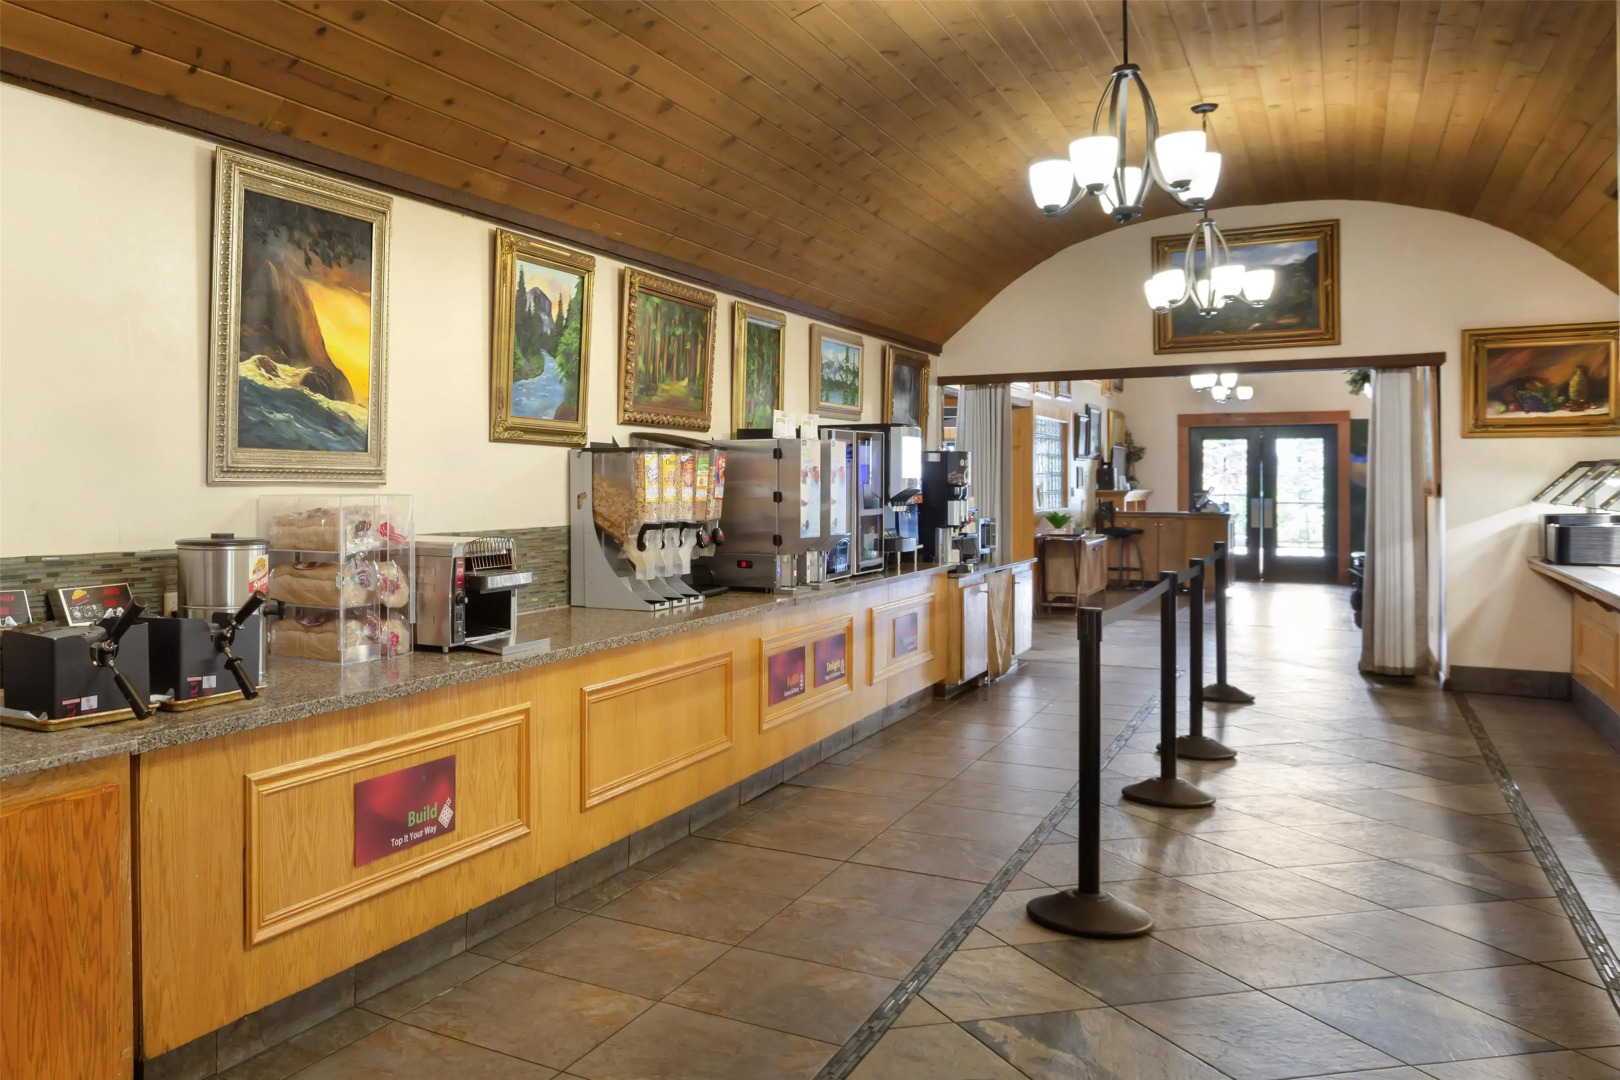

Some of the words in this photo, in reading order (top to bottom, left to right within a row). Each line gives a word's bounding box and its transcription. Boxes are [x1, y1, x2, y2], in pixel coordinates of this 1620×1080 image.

[827, 660, 841, 672] Delight
[408, 803, 438, 827] Build
[391, 838, 403, 847] Top
[403, 835, 409, 843] It
[410, 829, 424, 841] Your
[424, 825, 438, 835] Way
